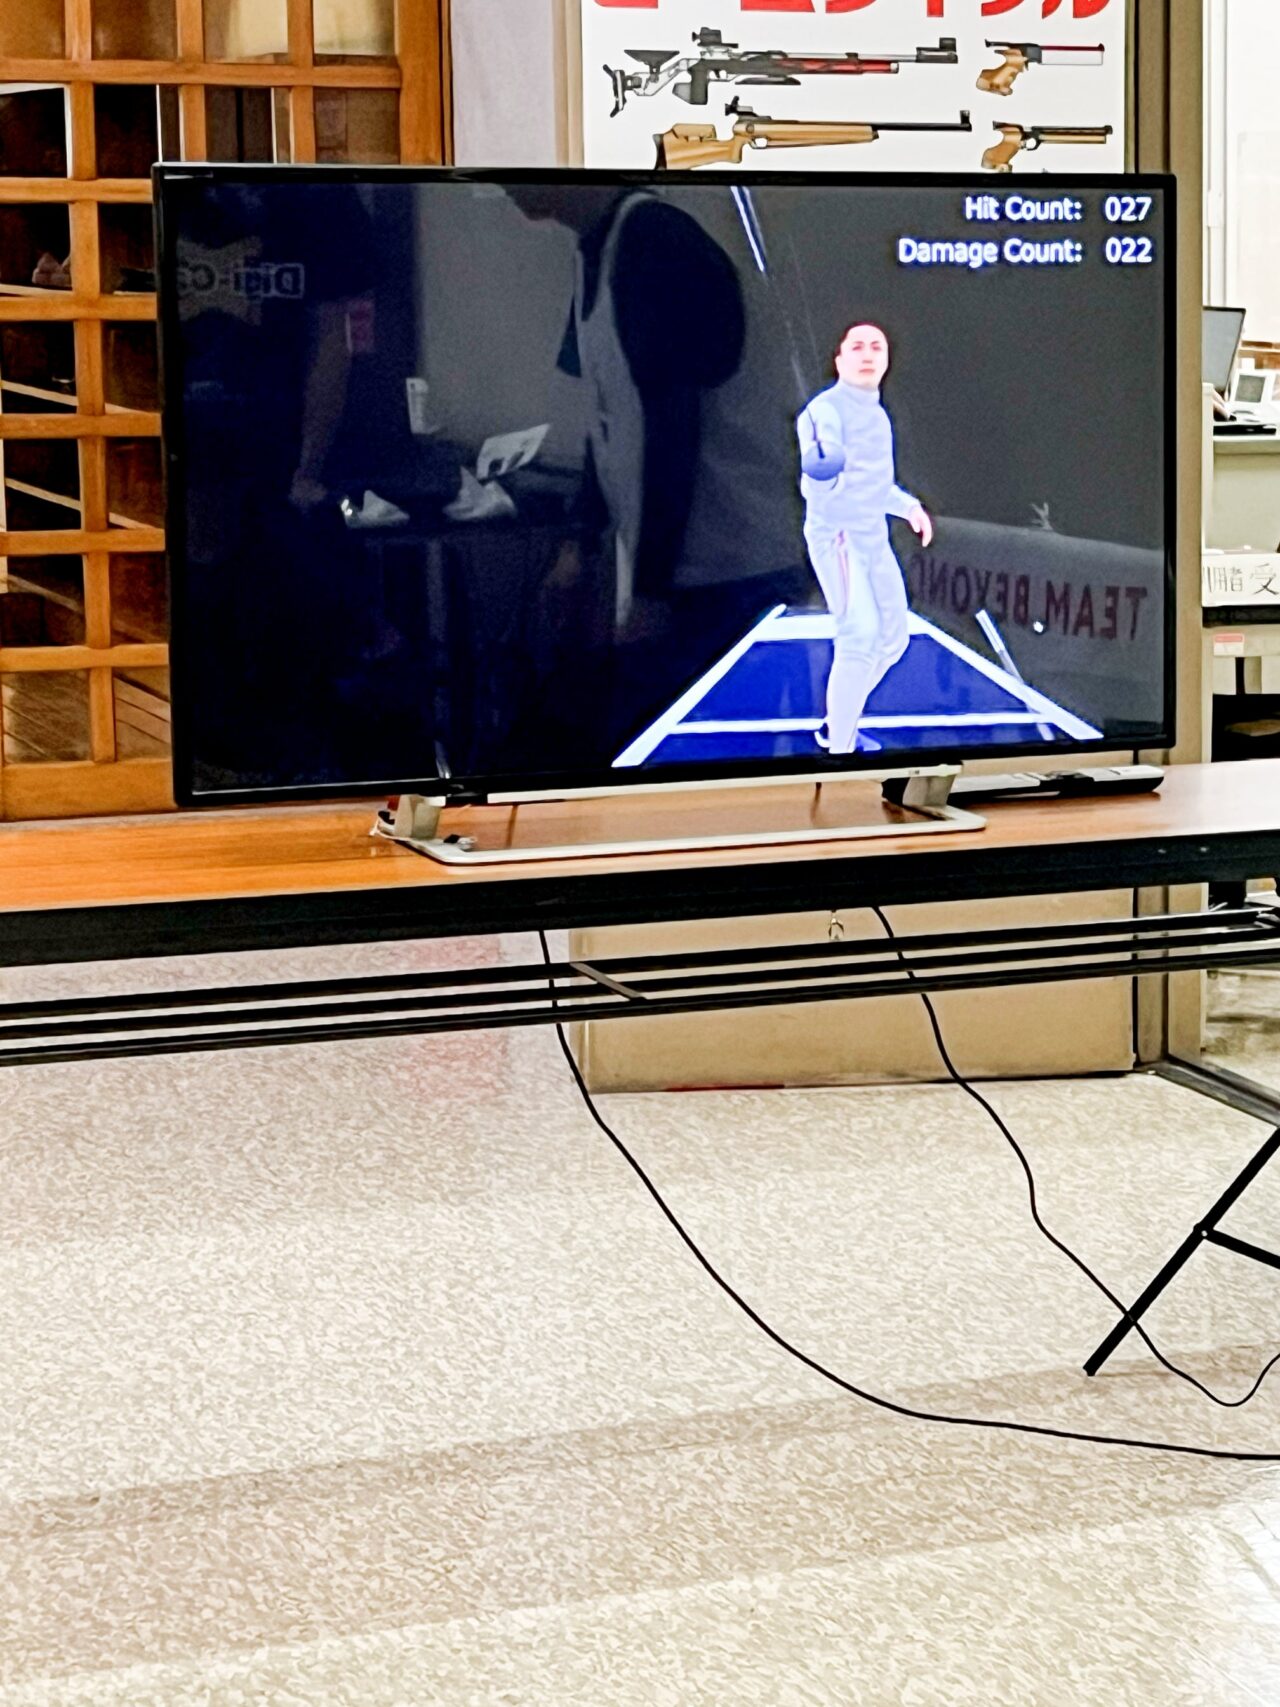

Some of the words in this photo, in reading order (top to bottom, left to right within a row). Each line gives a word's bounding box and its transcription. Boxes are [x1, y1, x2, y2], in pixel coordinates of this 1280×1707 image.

[965, 196, 999, 221] Hit
[1005, 196, 1082, 221] Count:
[1105, 196, 1152, 222] 027
[898, 238, 998, 269] Damage
[1003, 238, 1082, 263] Count:
[1105, 237, 1152, 263] 022
